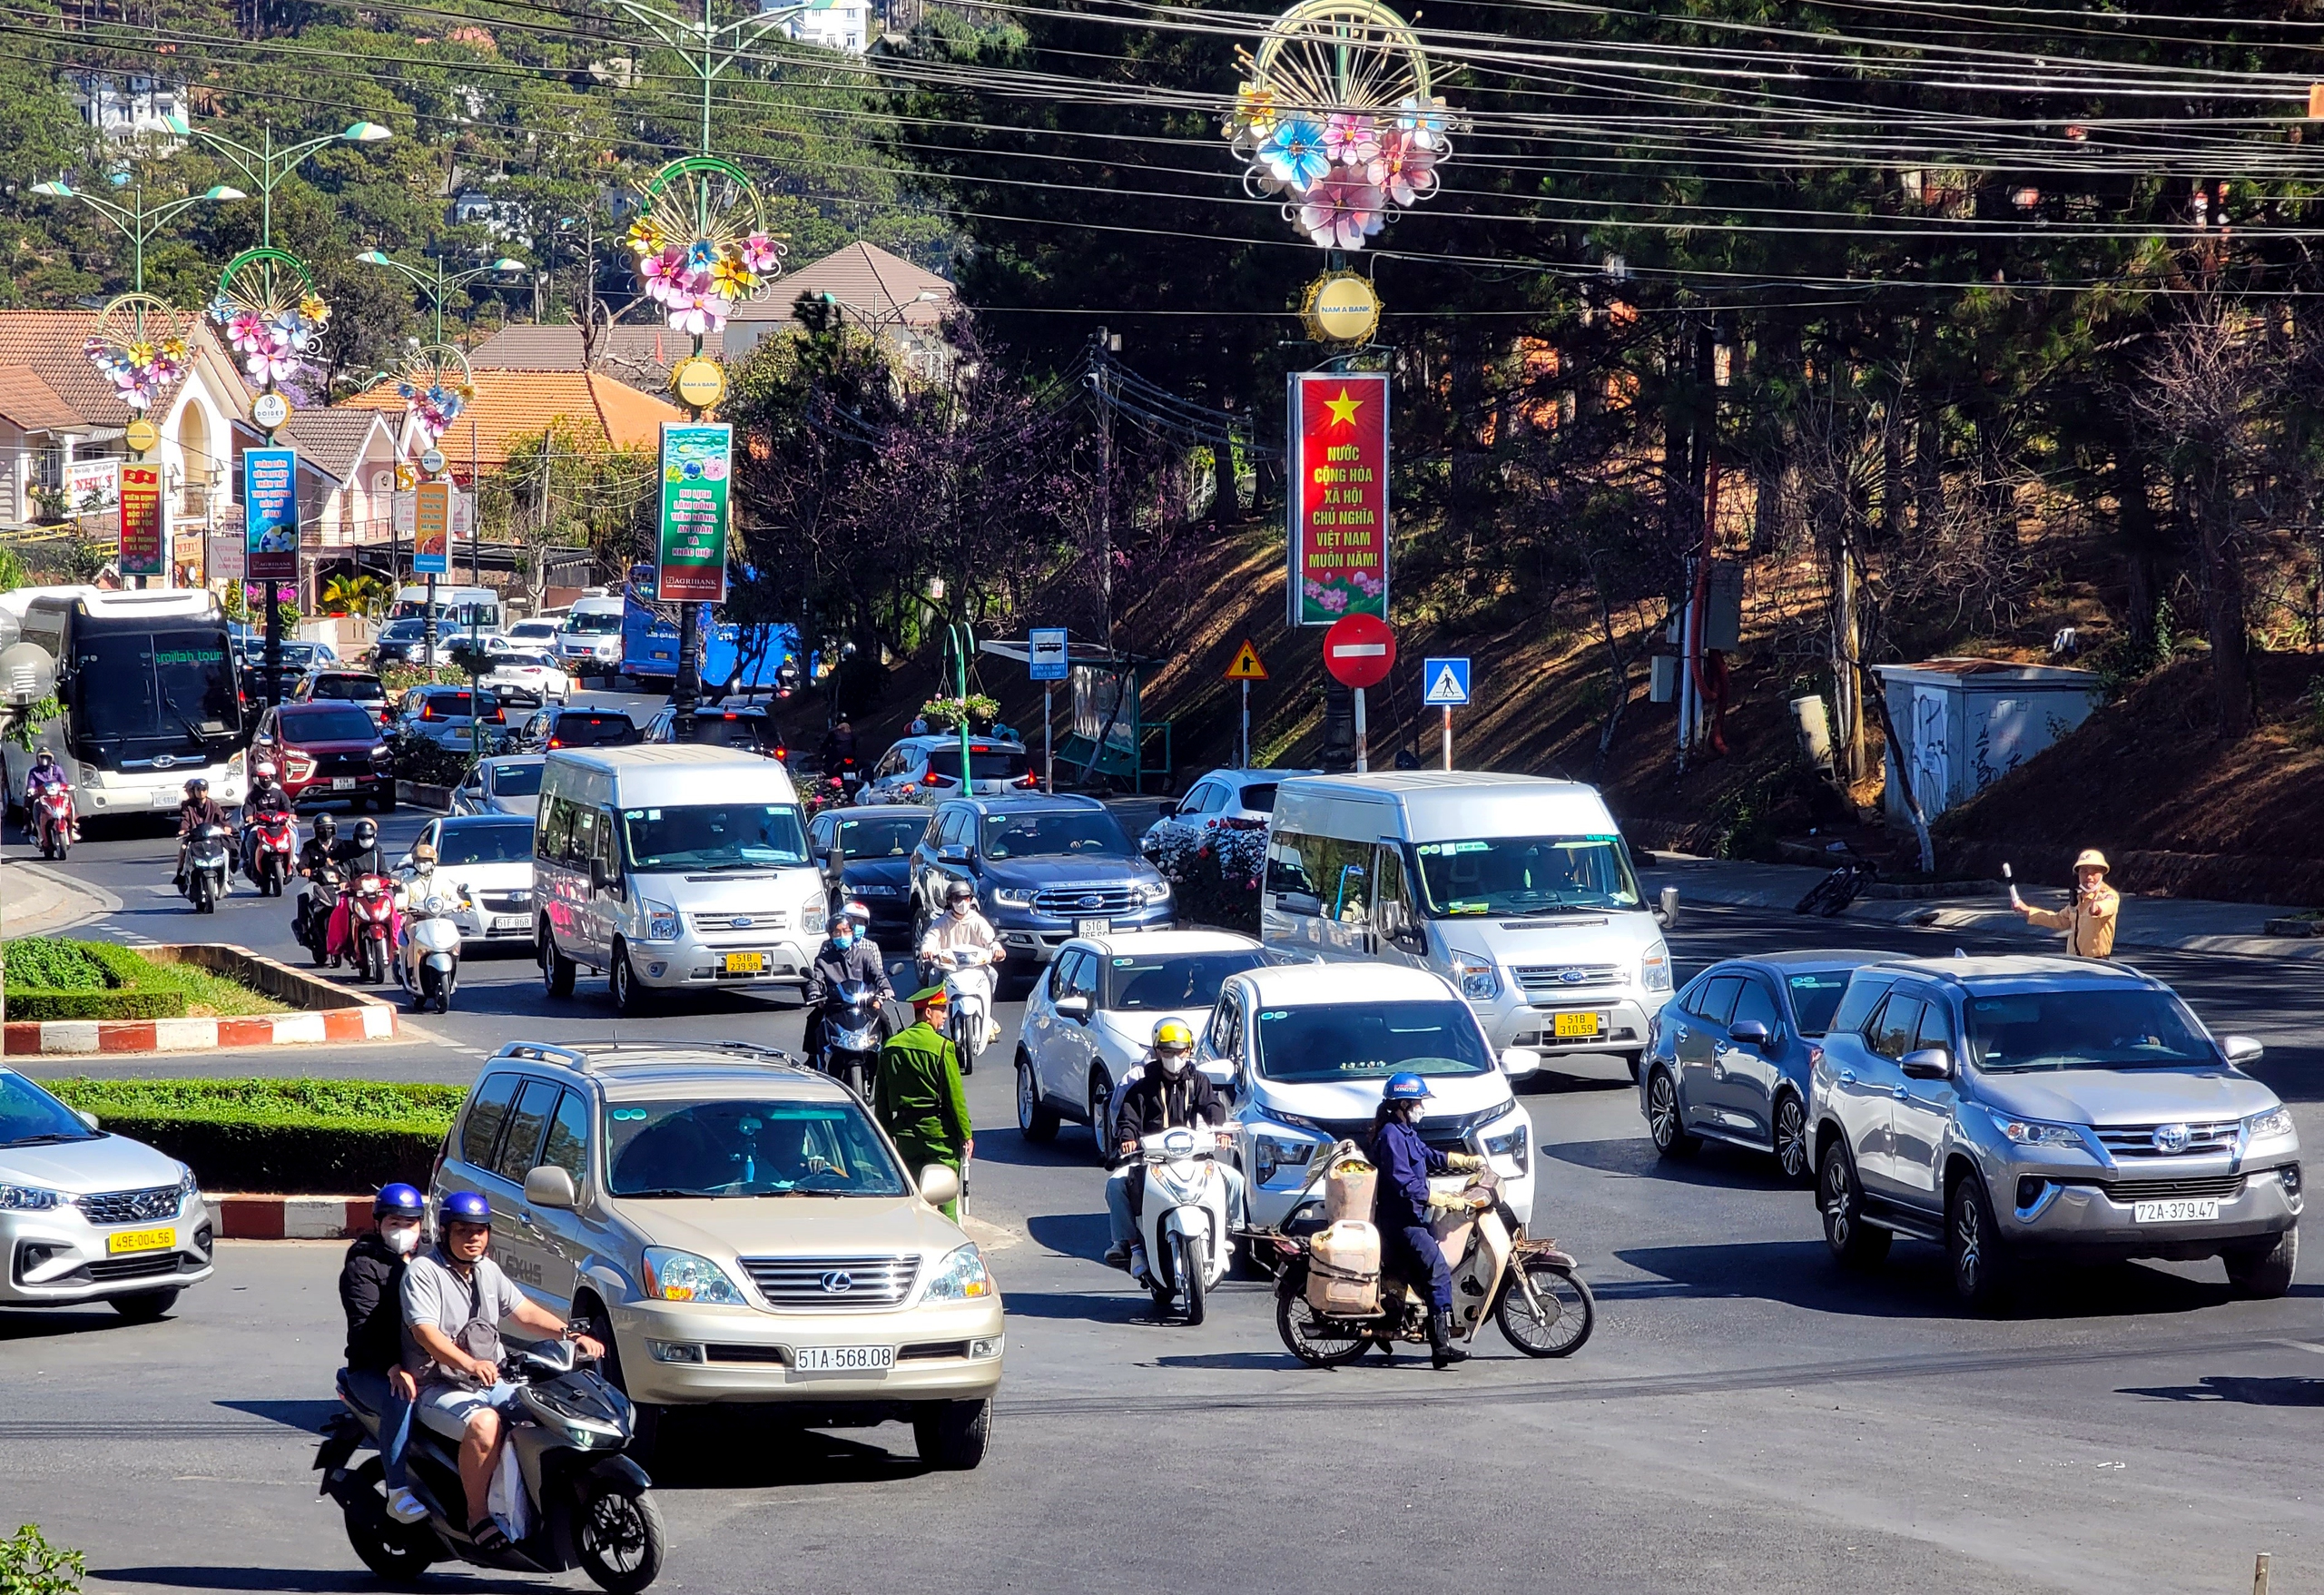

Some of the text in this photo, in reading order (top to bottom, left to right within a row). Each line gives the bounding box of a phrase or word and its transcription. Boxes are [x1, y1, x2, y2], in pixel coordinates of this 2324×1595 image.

[1327, 444, 1360, 461] NƯỚC
[1314, 465, 1373, 486] CỘNG HÒA
[679, 490, 711, 500] DU LỊCH
[1324, 487, 1363, 507] XÃ HỘI
[674, 500, 715, 510] LÂM ĐỒNG
[1313, 507, 1374, 525] CHỦ NGHĨA
[677, 524, 713, 534] AN TOÀN
[688, 536, 699, 545] VÀ
[1316, 529, 1371, 548] VIỆT NAM
[673, 547, 714, 558] KHÁC BIỆT
[1309, 550, 1378, 568] MUÔN NĂM!
[1086, 921, 1102, 930] 51G
[736, 954, 752, 962] 51B
[730, 962, 758, 970] 239.99
[1567, 1015, 1585, 1024] 51B
[1560, 1025, 1593, 1035] 310.59
[2138, 1202, 2215, 1220] 72A-379.47
[116, 1232, 170, 1248] 49E-004.56
[799, 1348, 891, 1368] 51A-568.08
